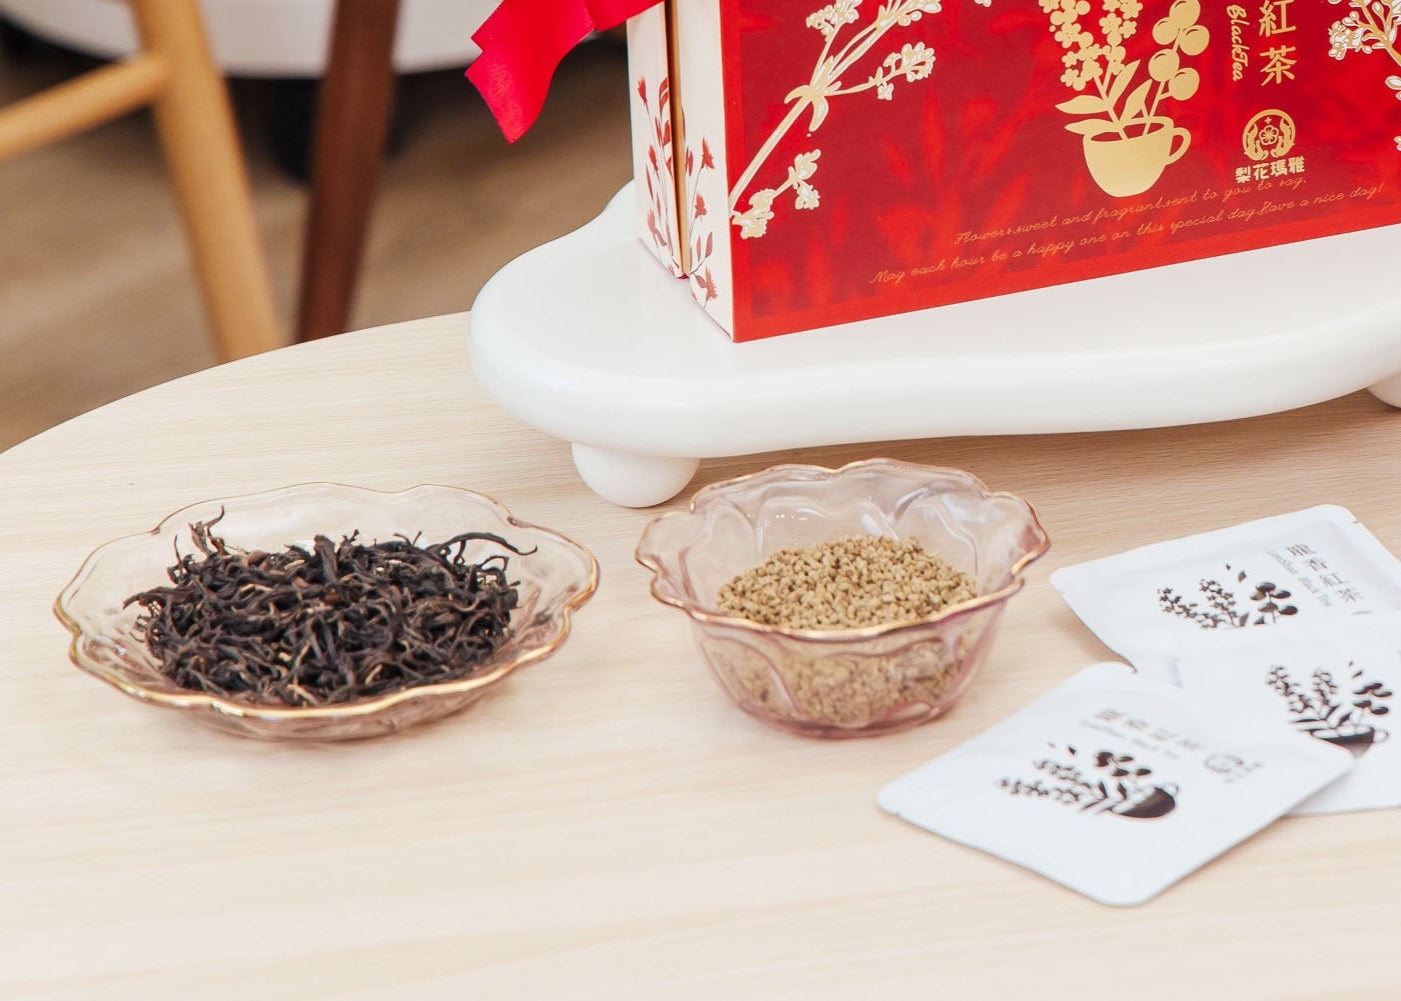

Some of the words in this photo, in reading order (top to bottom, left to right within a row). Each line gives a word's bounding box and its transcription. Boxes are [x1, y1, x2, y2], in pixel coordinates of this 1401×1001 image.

[1235, 155, 1305, 184] 梨花瑪雅
[1061, 210, 1094, 226] and
[1202, 188, 1219, 201] to
[1222, 185, 1251, 202] you
[1256, 179, 1273, 191] to
[868, 270, 906, 285] May
[910, 259, 946, 277] each
[950, 255, 986, 269] hour
[990, 249, 1008, 261] be
[1012, 250, 1024, 258] a
[1027, 240, 1075, 257] happy
[1079, 234, 1108, 246] one
[1136, 222, 1164, 236] this
[1170, 209, 1224, 235] special
[1300, 199, 1311, 207] a
[1314, 190, 1346, 204] nice
